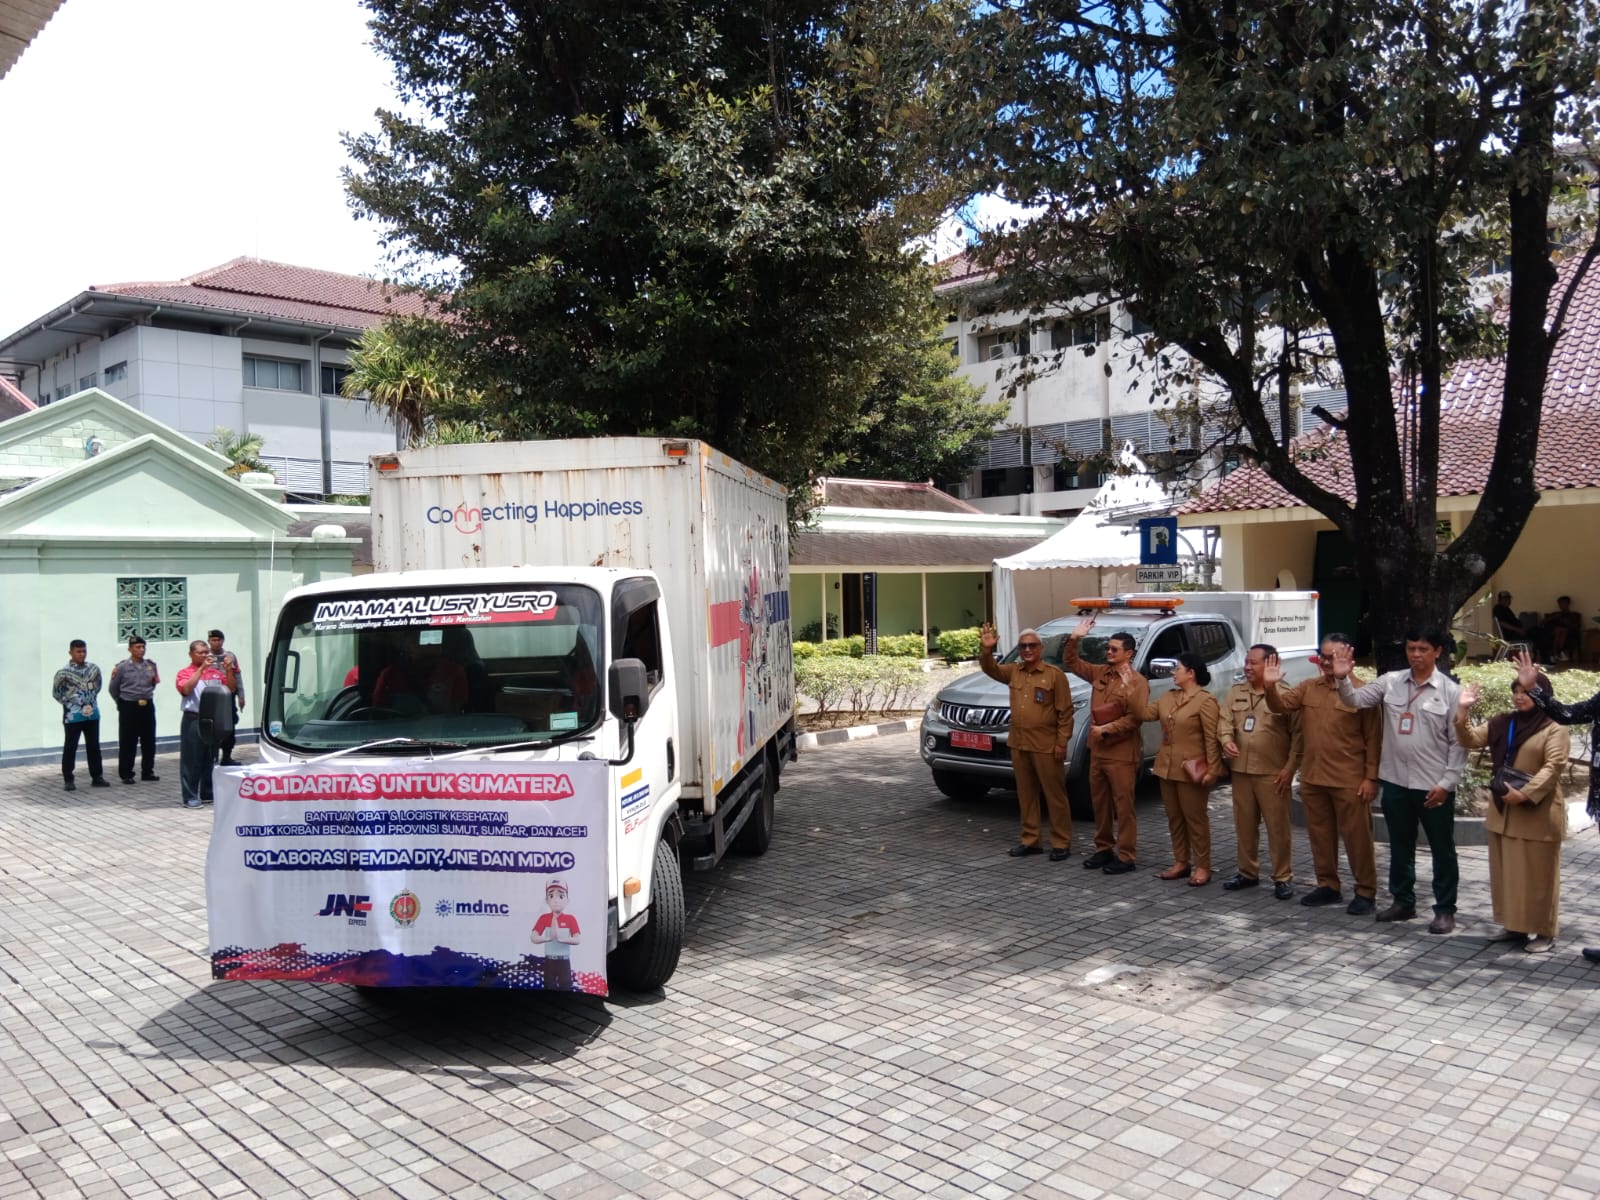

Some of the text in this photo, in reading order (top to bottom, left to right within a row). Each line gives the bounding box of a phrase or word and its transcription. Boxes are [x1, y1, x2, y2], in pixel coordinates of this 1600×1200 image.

[426, 498, 644, 525] Connecting Happiness
[1150, 526, 1169, 554] P
[1138, 570, 1180, 580] PARKIR VIP
[240, 775, 573, 796] SOLIDARITAS UNTUK SUMATERA
[305, 810, 509, 822] BANTUAN OBAT & LOGISTIK KESEHATAN
[236, 824, 588, 837] UNTUK KORBAN BENCANA DI PROVINSI SUMUT, SUMBAR, DAN ACEH
[245, 851, 575, 868] KOLABORASI PEMDA DIY, JNE DAN MDMC
[318, 893, 373, 918] JNE
[456, 899, 510, 915] mdmc
